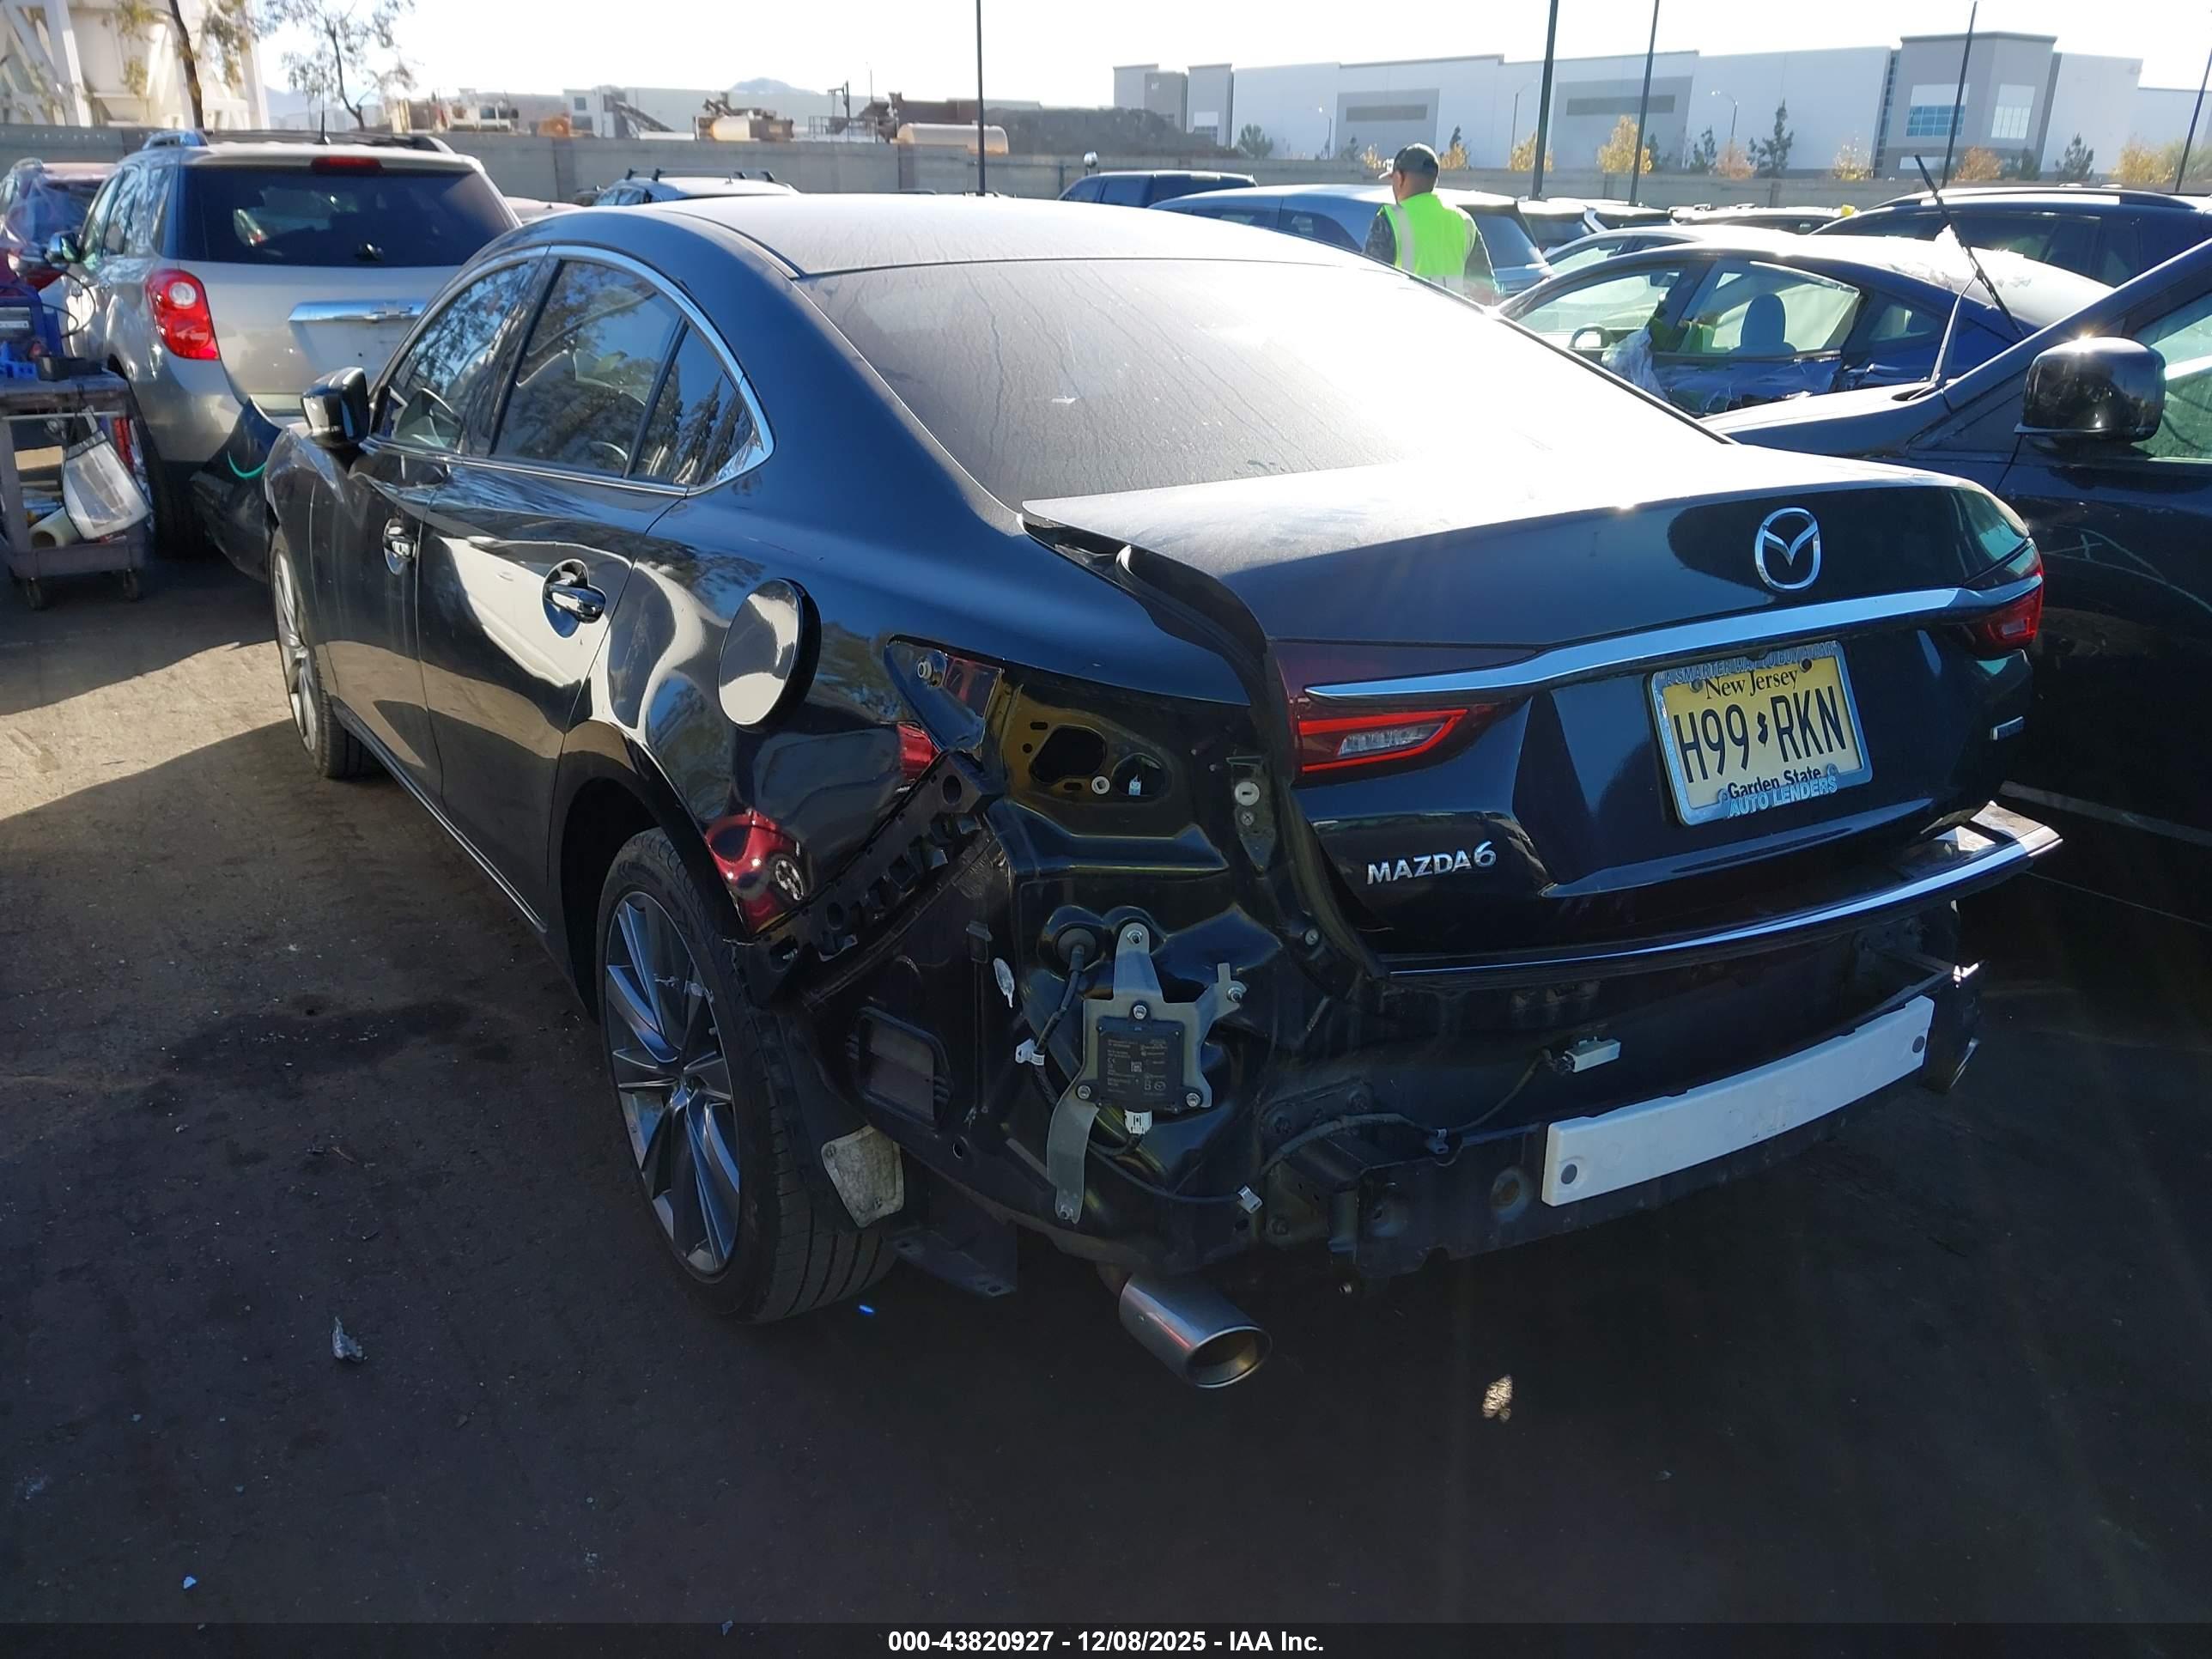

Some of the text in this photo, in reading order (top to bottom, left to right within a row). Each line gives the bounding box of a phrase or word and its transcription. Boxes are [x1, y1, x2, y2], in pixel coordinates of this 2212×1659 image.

[1675, 660, 1732, 684] SMARTER
[1778, 646, 1799, 666] BUY
[1705, 668, 1798, 700] New Jersey
[1674, 685, 1846, 784] H99 RKN
[1727, 766, 1822, 799] Garden State
[1728, 775, 1838, 817] AUTO LENDERS
